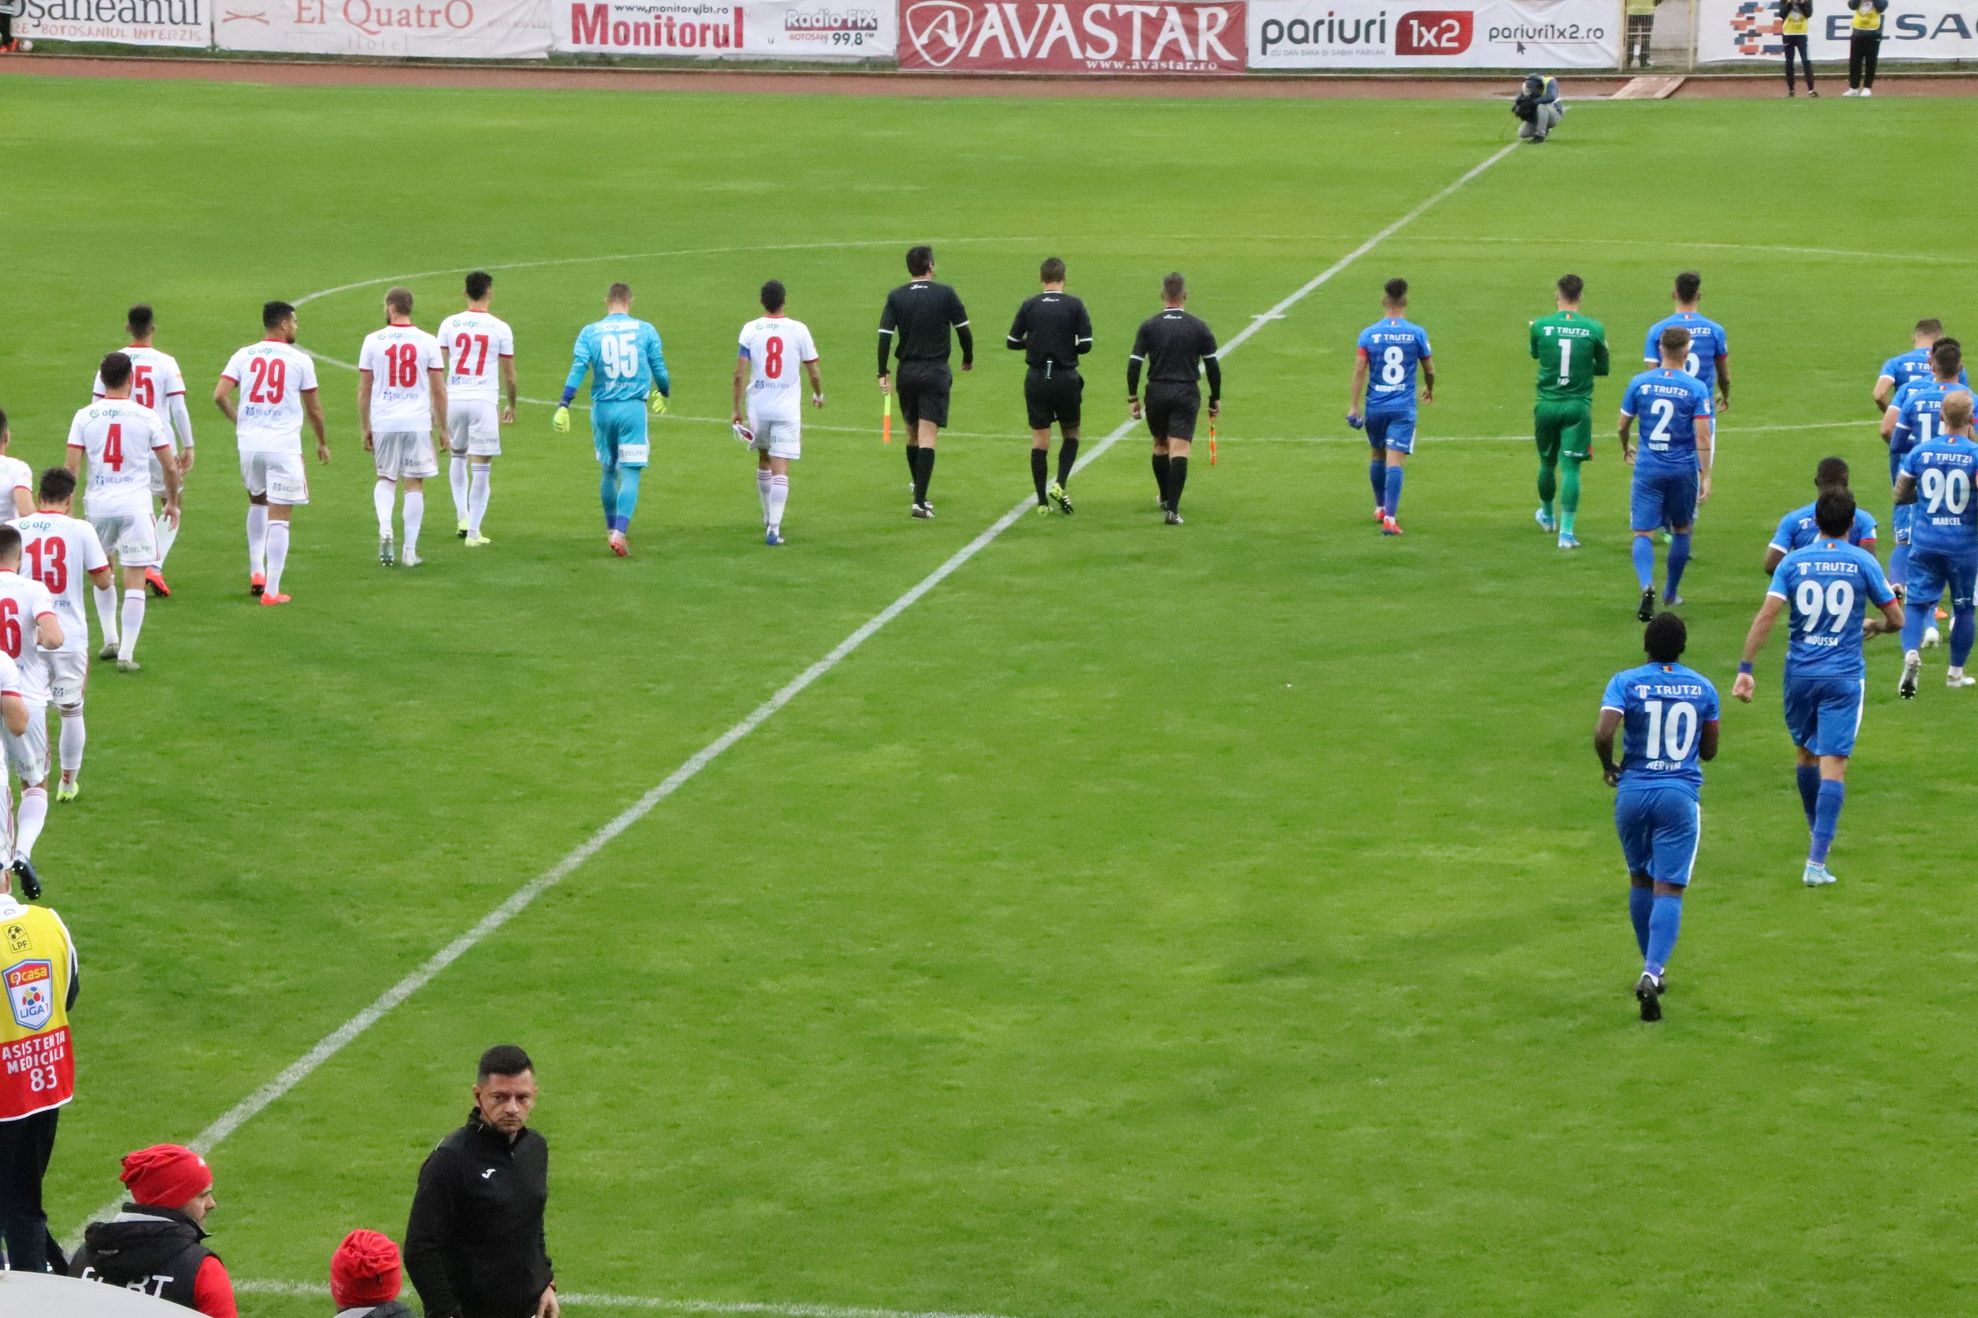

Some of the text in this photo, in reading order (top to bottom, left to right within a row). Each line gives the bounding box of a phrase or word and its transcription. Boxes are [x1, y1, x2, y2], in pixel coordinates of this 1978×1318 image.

[293, 0, 326, 24] El
[572, 4, 744, 48] Monitorul
[785, 8, 876, 28] Radio FIX
[1826, 13, 1978, 41] ELSA
[134, 28, 203, 42] INTERZIS
[968, 3, 1238, 60] AVASTAR
[1261, 11, 1386, 56] pariuri
[1409, 19, 1461, 48] 1x2
[1489, 24, 1605, 42] pariuri1x2.ro
[1086, 60, 1217, 71] www.avastar.ro
[1383, 333, 1415, 342] TRUTZI
[1556, 326, 1590, 336] TRUTZI
[384, 343, 417, 389] 18
[455, 332, 489, 377] 27
[600, 332, 639, 379] 95
[765, 335, 784, 380] 8
[1381, 345, 1405, 385] 8
[1558, 338, 1572, 377] 1
[249, 356, 286, 404] 29
[1653, 384, 1688, 397] TRUTZI
[1649, 398, 1675, 442] 2
[103, 423, 124, 472] 4
[1936, 452, 1973, 464] TRUTZI
[1921, 467, 1971, 515] 90
[25, 536, 67, 595] 13
[1814, 561, 1859, 573] TRUTZI
[54, 600, 71, 608] FRY
[1795, 579, 1855, 633] 99
[1654, 684, 1702, 696] TRUTZI
[1644, 700, 1698, 761] 10
[12, 940, 28, 951] LPF
[2, 1030, 66, 1060] ASISTENTA
[30, 1064, 58, 1092] 83
